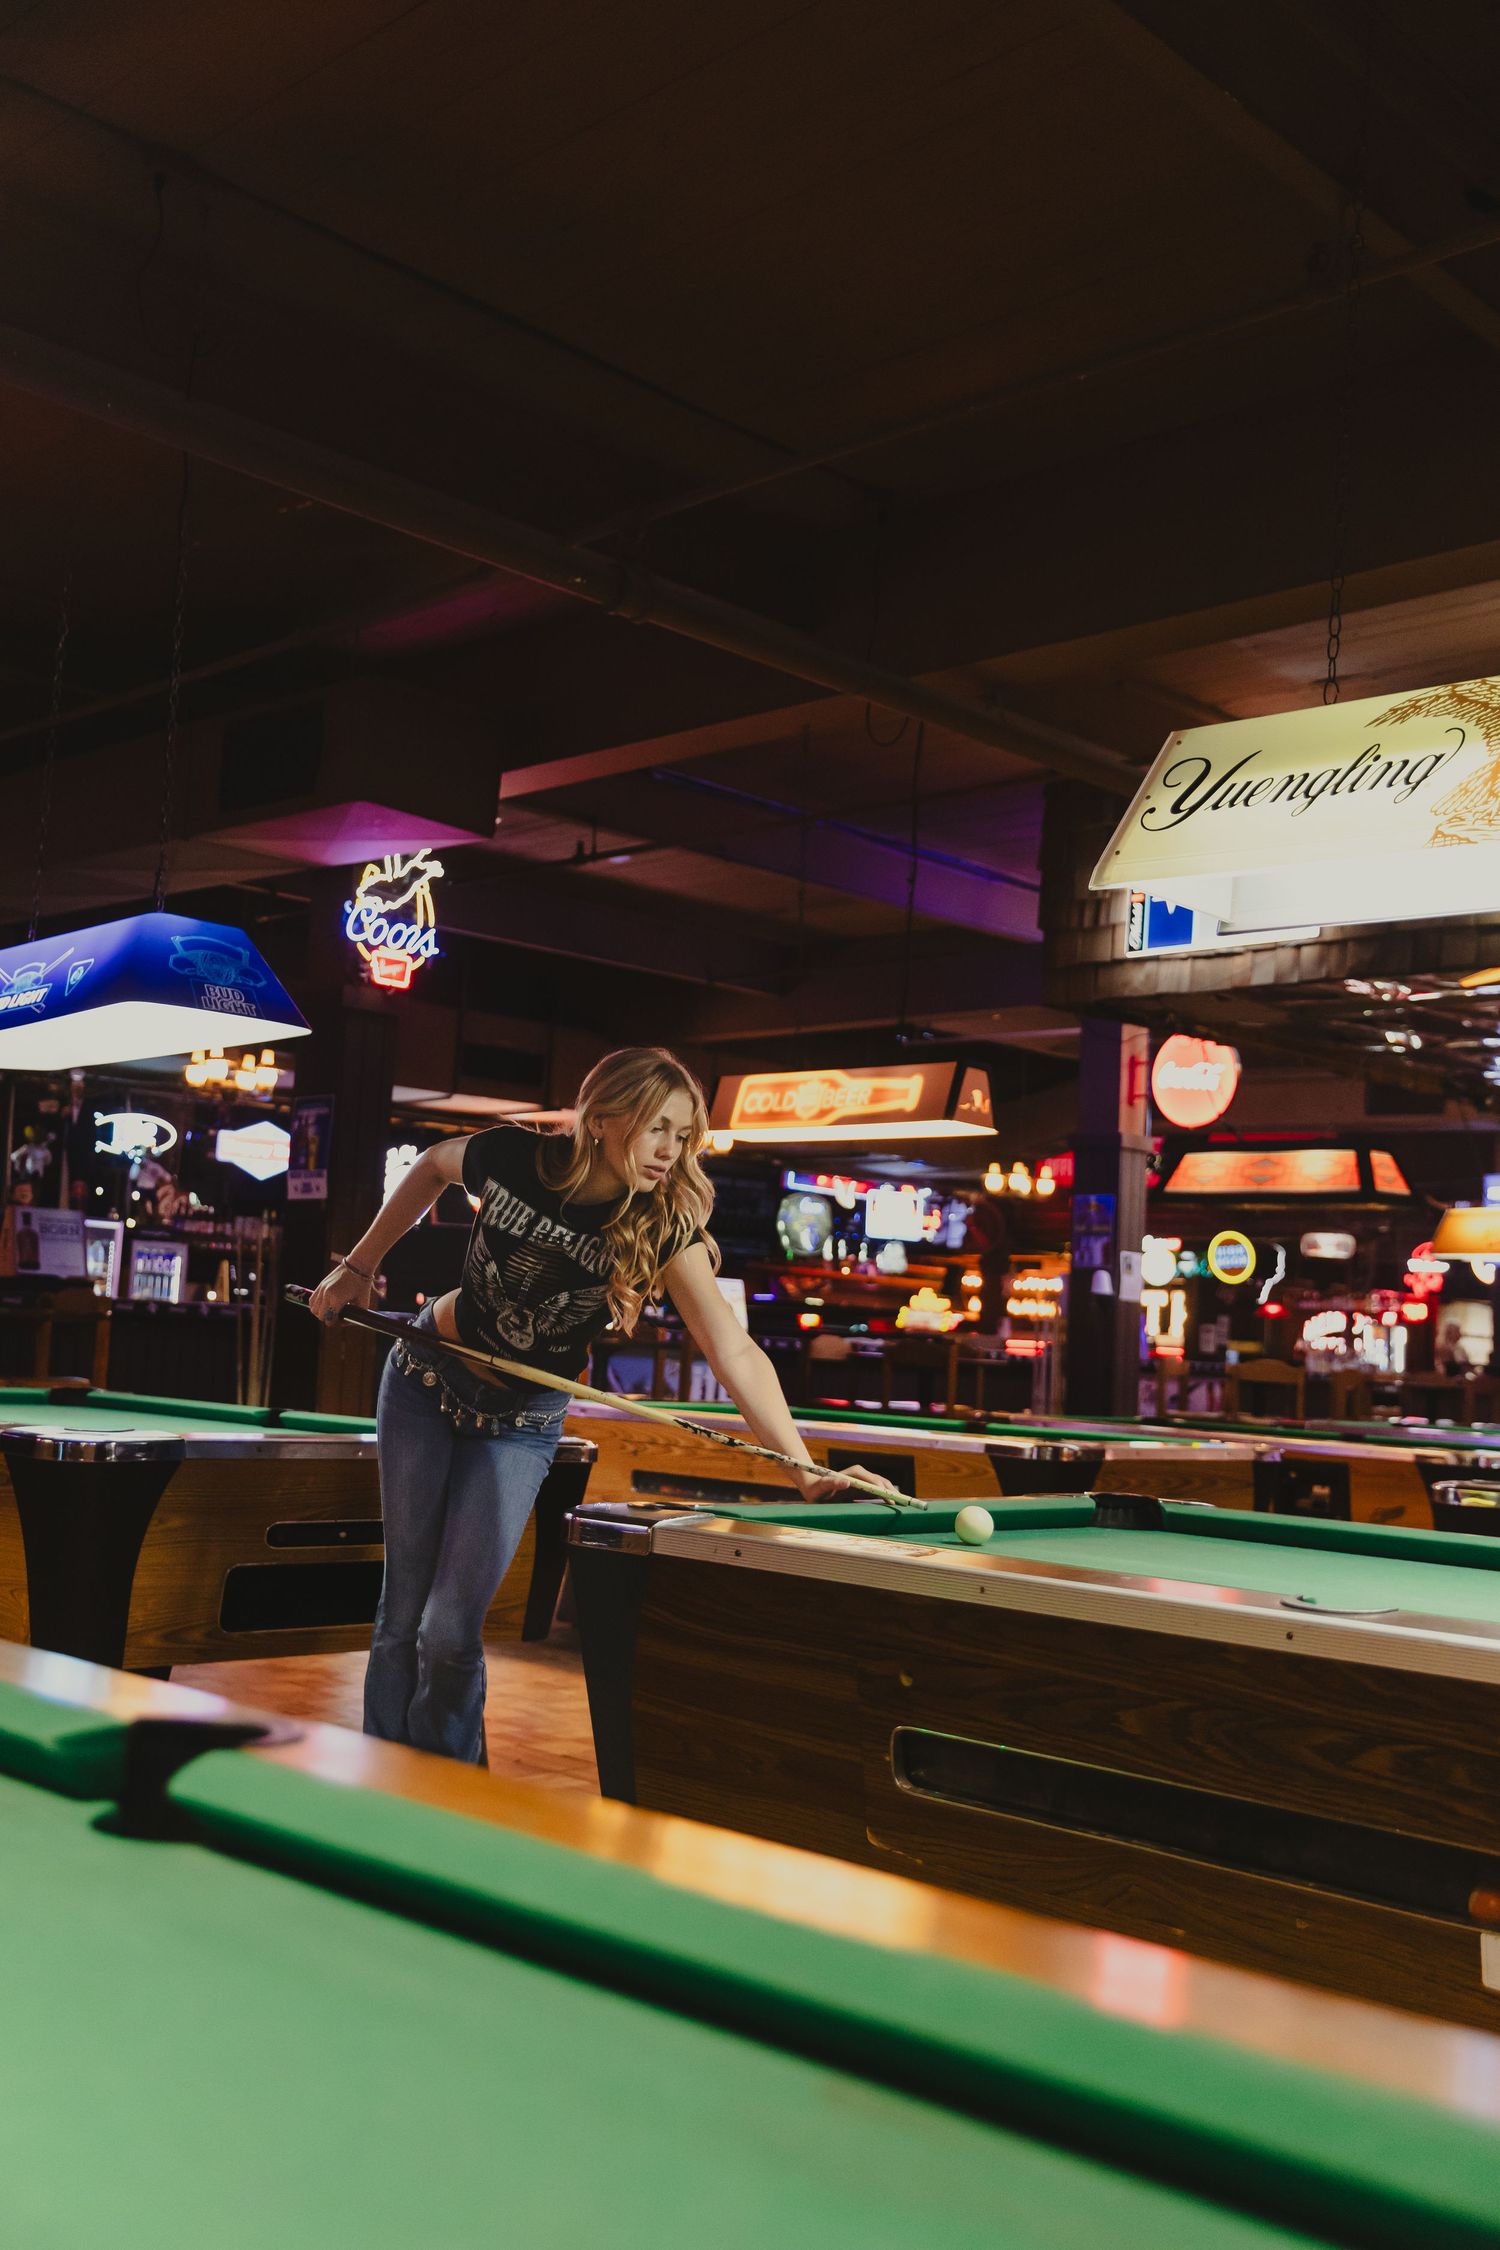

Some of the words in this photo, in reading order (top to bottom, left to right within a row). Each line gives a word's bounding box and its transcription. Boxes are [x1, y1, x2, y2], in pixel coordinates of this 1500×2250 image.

[1140, 727, 1466, 832] Yuengling
[344, 897, 440, 958] Coors
[201, 996, 257, 1017] LIGHT
[204, 984, 245, 1004] BUD
[742, 1090, 799, 1114] COLD
[821, 1086, 873, 1110] BEER
[482, 1176, 537, 1238] TRUE
[527, 1215, 617, 1277] RELIGIO
